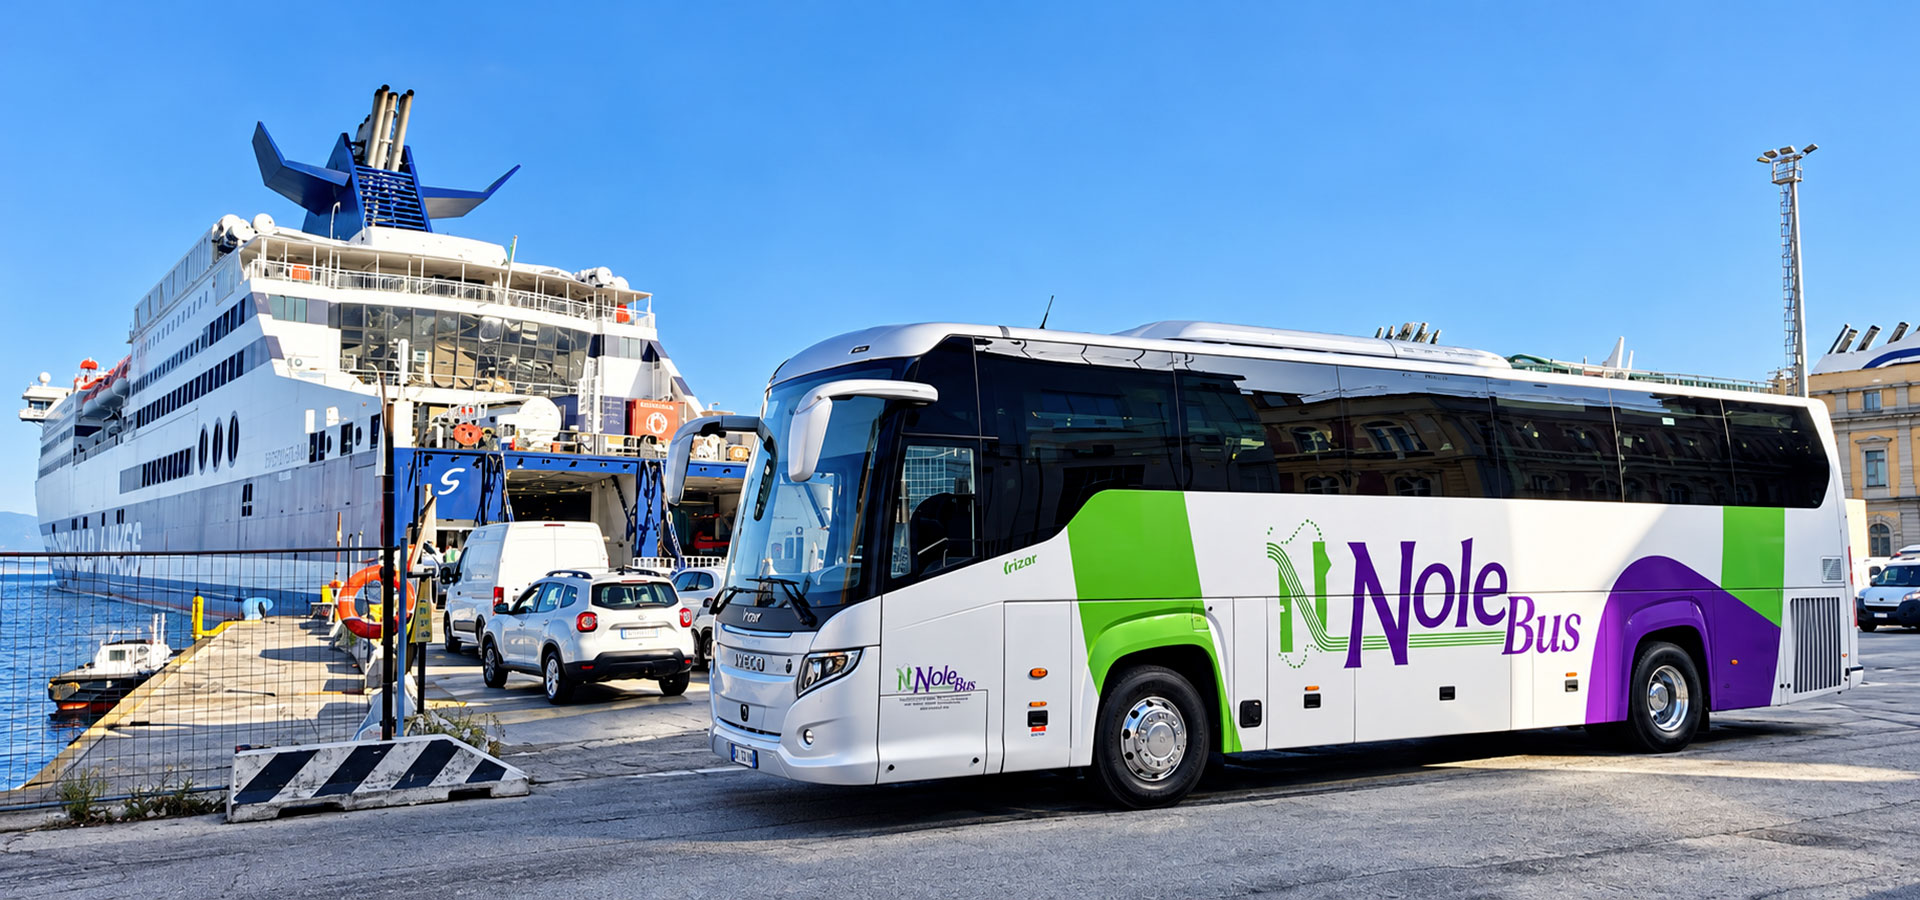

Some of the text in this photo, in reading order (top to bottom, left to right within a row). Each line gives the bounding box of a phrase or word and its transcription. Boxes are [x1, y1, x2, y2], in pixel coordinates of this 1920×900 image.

[437, 467, 466, 496] S
[1344, 537, 1508, 668] Nole
[1501, 595, 1582, 655] Bus
[913, 665, 957, 694] Nole
[954, 677, 976, 692] Bus
